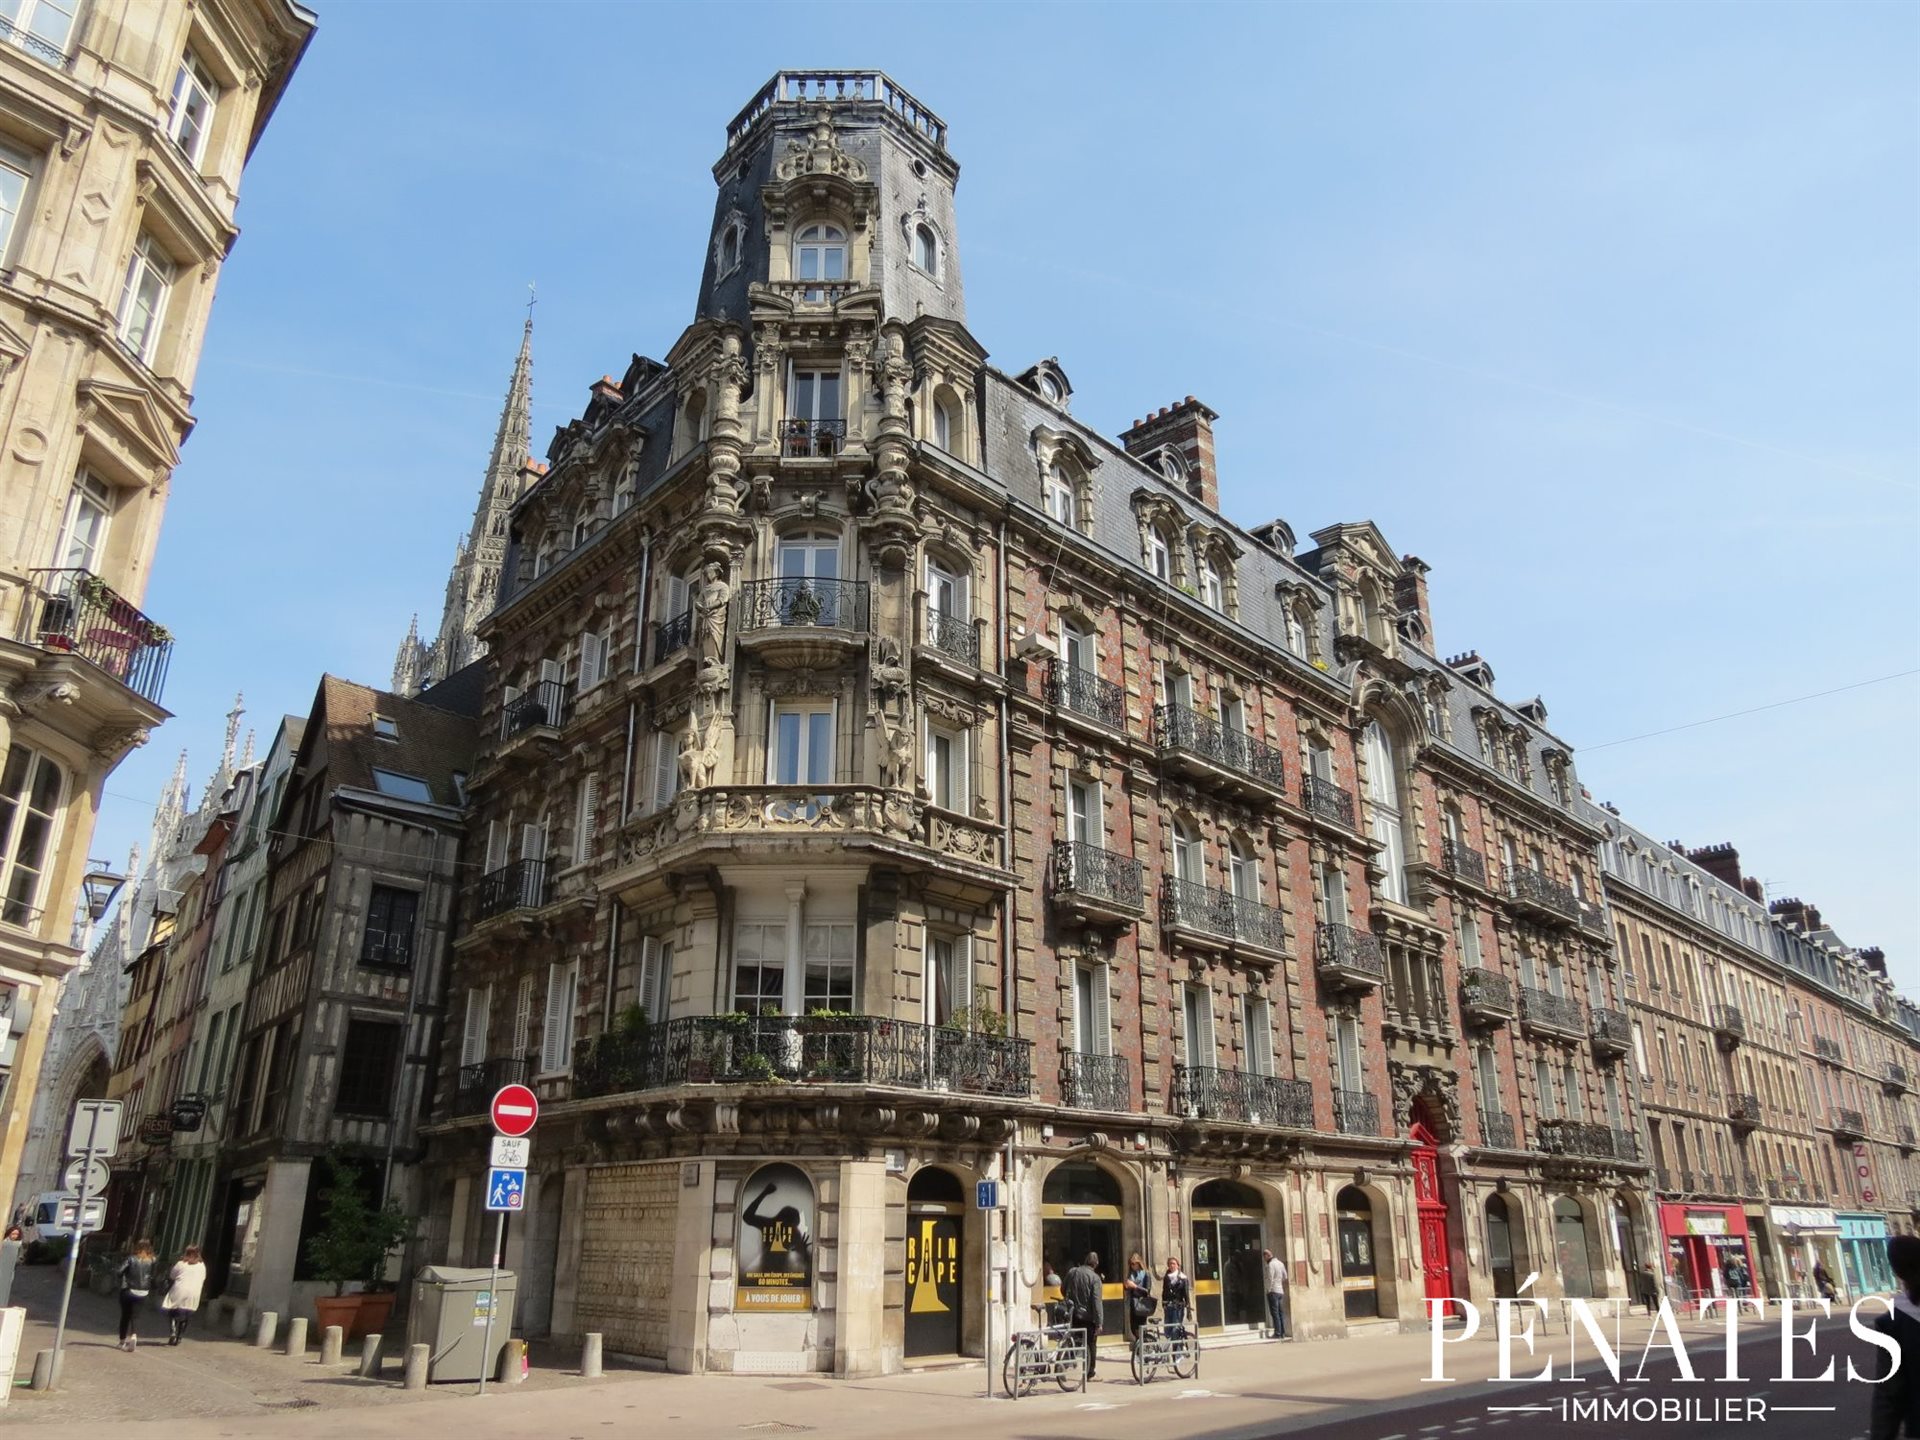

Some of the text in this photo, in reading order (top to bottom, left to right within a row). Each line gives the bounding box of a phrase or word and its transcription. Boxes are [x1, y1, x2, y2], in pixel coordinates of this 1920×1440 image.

[501, 1139, 522, 1148] SAUF
[908, 1237, 956, 1259] RAIN
[908, 1261, 956, 1285] CAPE
[751, 1293, 770, 1303] VOUS
[770, 1293, 780, 1303] DE
[779, 1293, 801, 1304] JOUER
